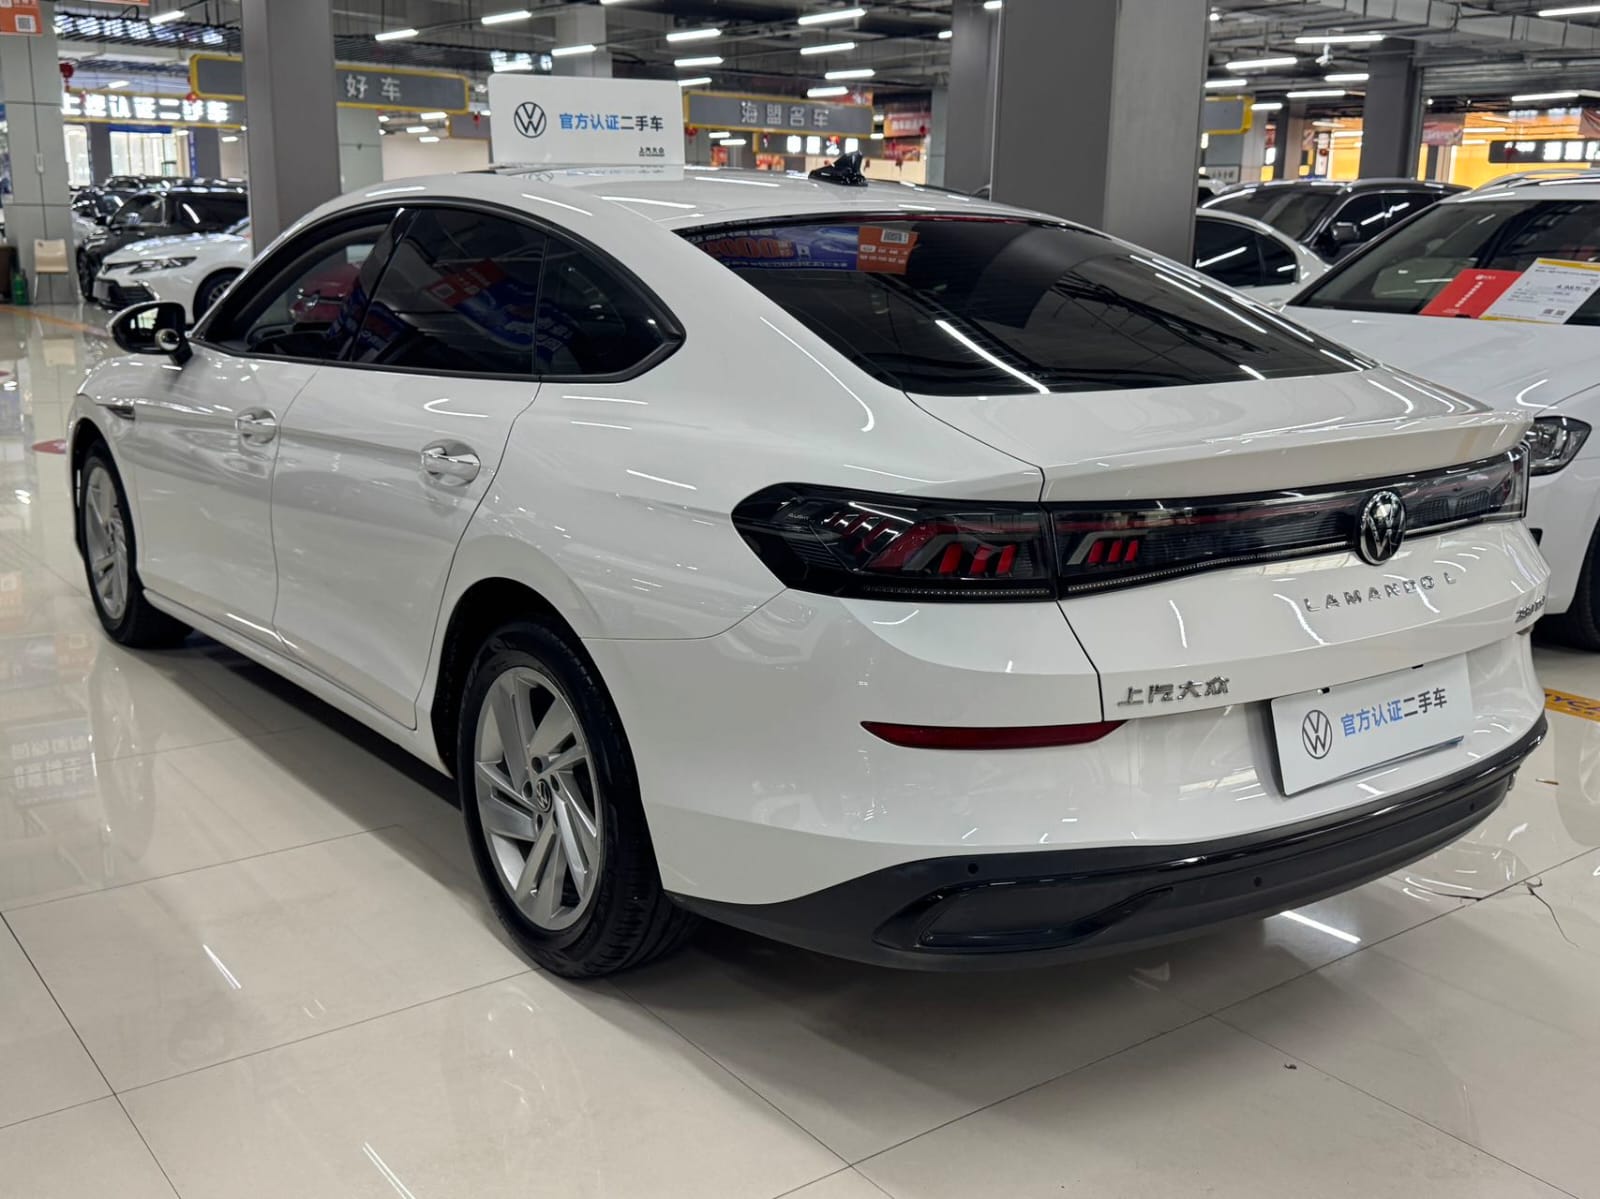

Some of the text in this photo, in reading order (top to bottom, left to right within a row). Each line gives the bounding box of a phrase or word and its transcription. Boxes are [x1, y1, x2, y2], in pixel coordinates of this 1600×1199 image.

[559, 113, 663, 132] 官方认证二手车
[1303, 572, 1457, 612] LAMANDO L
[1117, 676, 1230, 707] 上汽大众
[1340, 688, 1447, 737] 官方认证二手车
